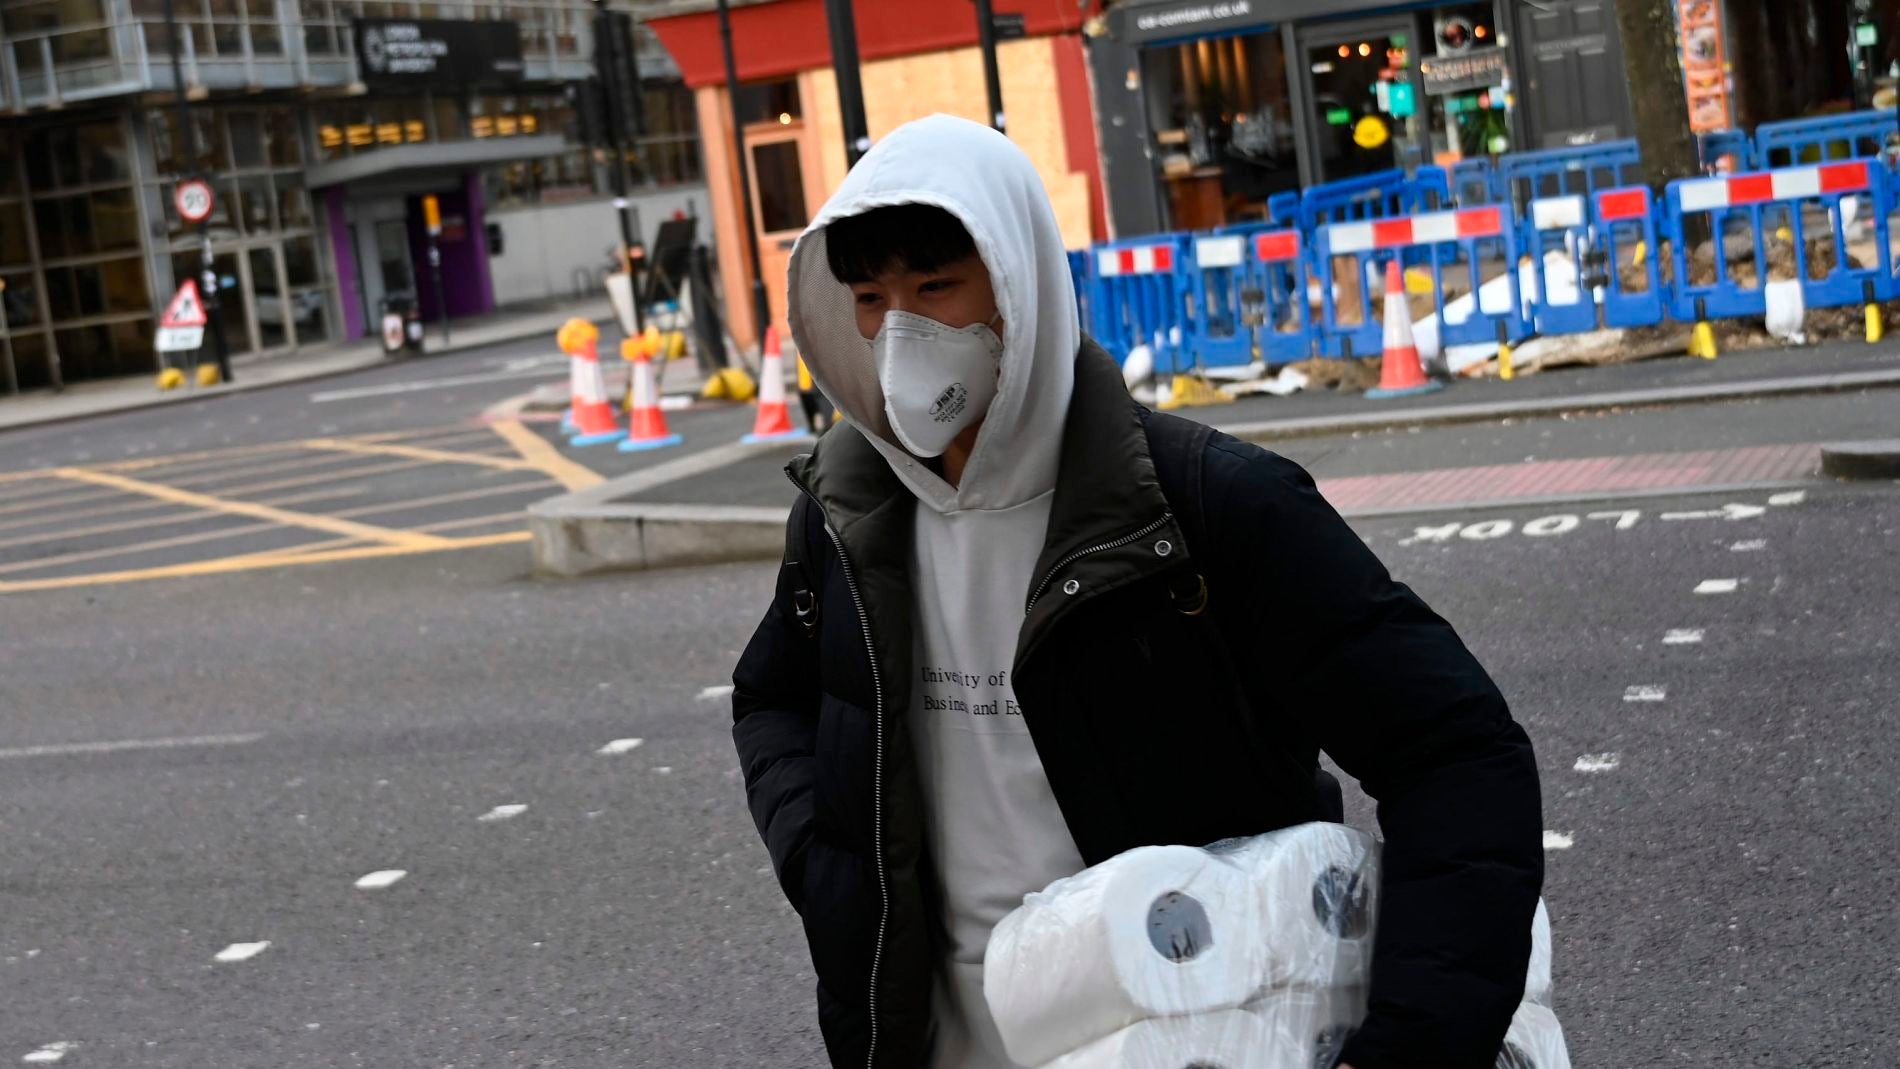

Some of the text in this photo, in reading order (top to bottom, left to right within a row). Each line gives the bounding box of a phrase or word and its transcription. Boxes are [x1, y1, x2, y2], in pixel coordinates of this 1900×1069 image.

[937, 387, 956, 412] JSP
[1398, 510, 1641, 546] LOOK
[921, 667, 1005, 689] Univeity of
[923, 695, 969, 714] Busine
[973, 701, 998, 716] and
